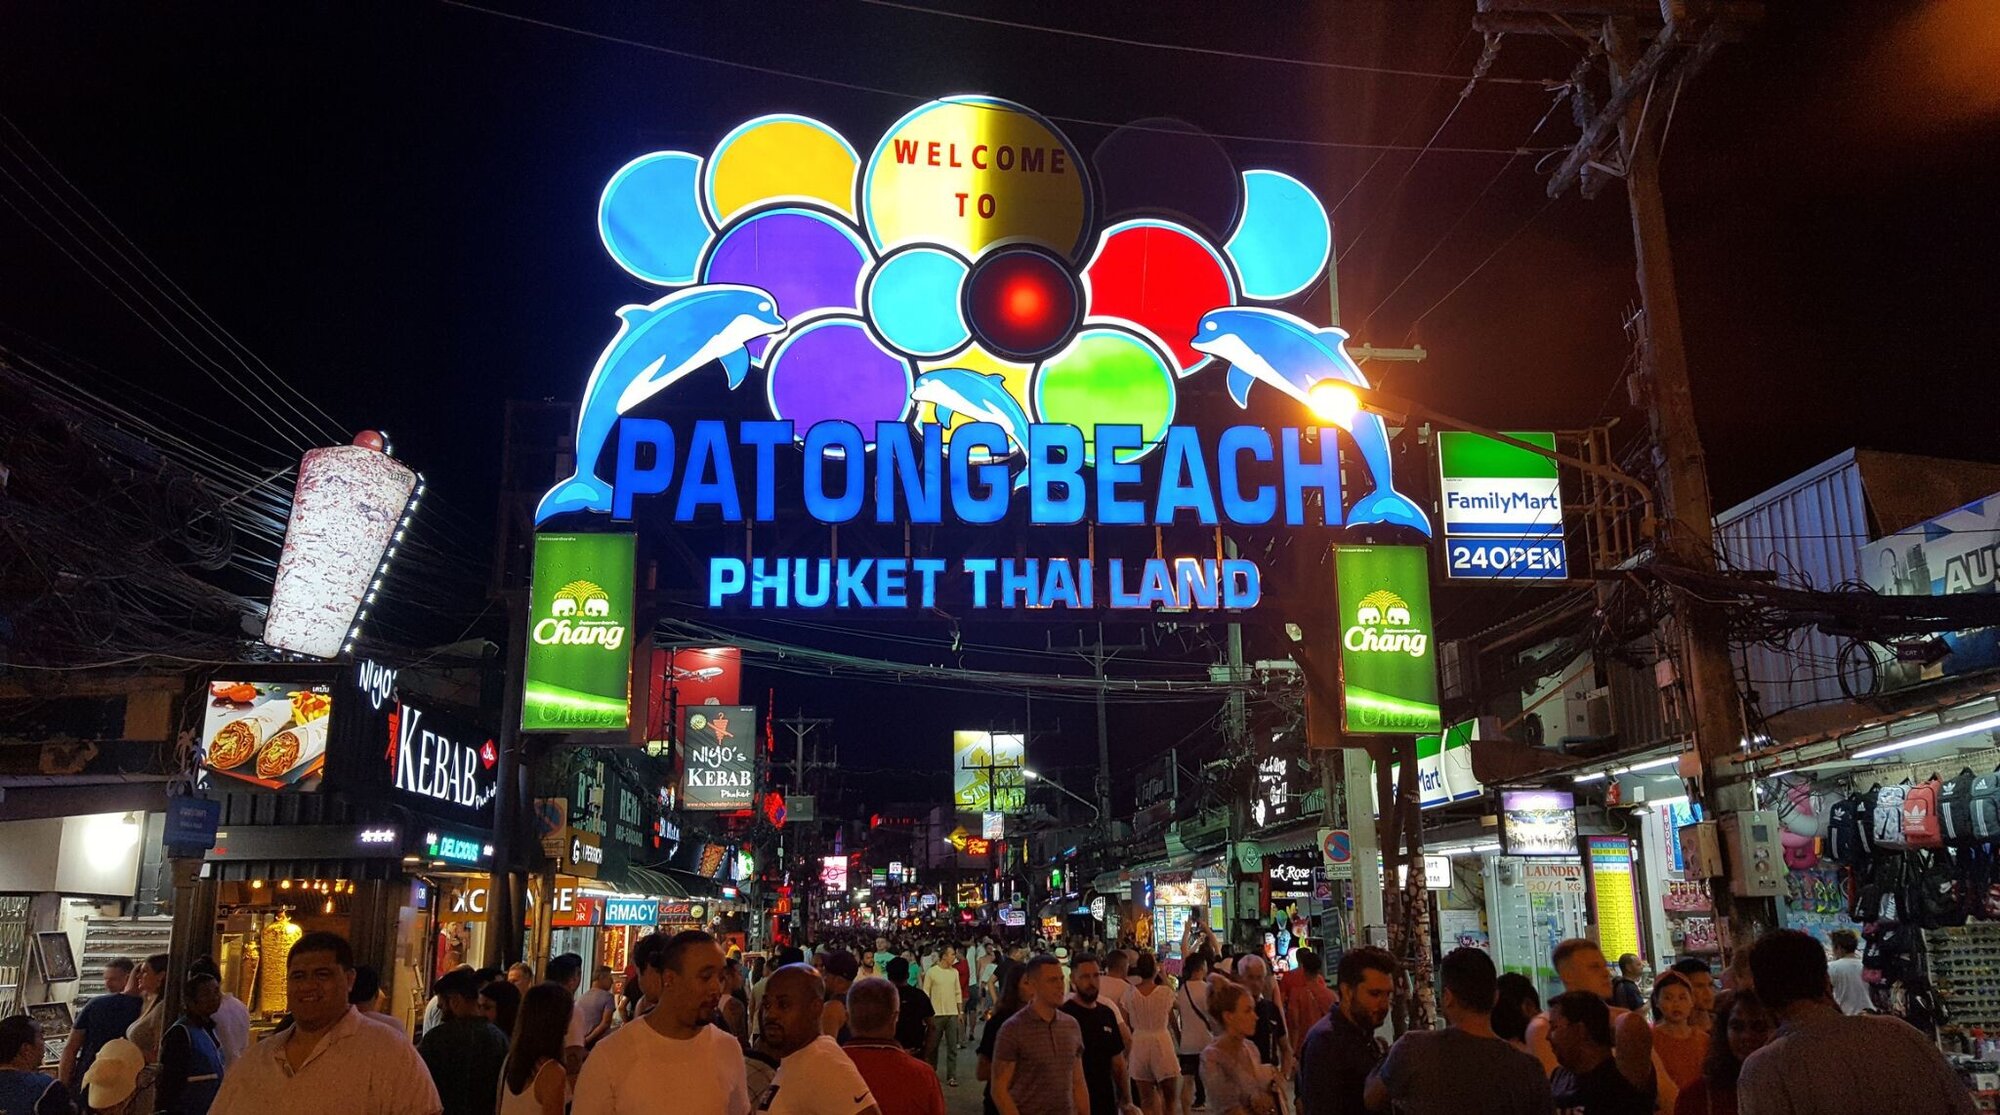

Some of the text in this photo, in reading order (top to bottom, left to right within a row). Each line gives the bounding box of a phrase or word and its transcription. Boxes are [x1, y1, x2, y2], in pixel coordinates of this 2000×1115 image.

[893, 138, 1066, 175] WELCOME
[955, 192, 997, 220] TO
[611, 417, 1344, 526] PATONG BEACH
[1447, 491, 1558, 514] FamilyMart
[709, 557, 946, 609] PHUKET
[533, 617, 625, 650] Chang
[1344, 624, 1428, 658] Chang
[395, 704, 478, 808] KEBAB
[687, 768, 751, 787] KEBAB
[440, 837, 480, 862] DELICIOUS
[1286, 865, 1310, 881] Rose
[1526, 865, 1582, 877] LAUNDRY
